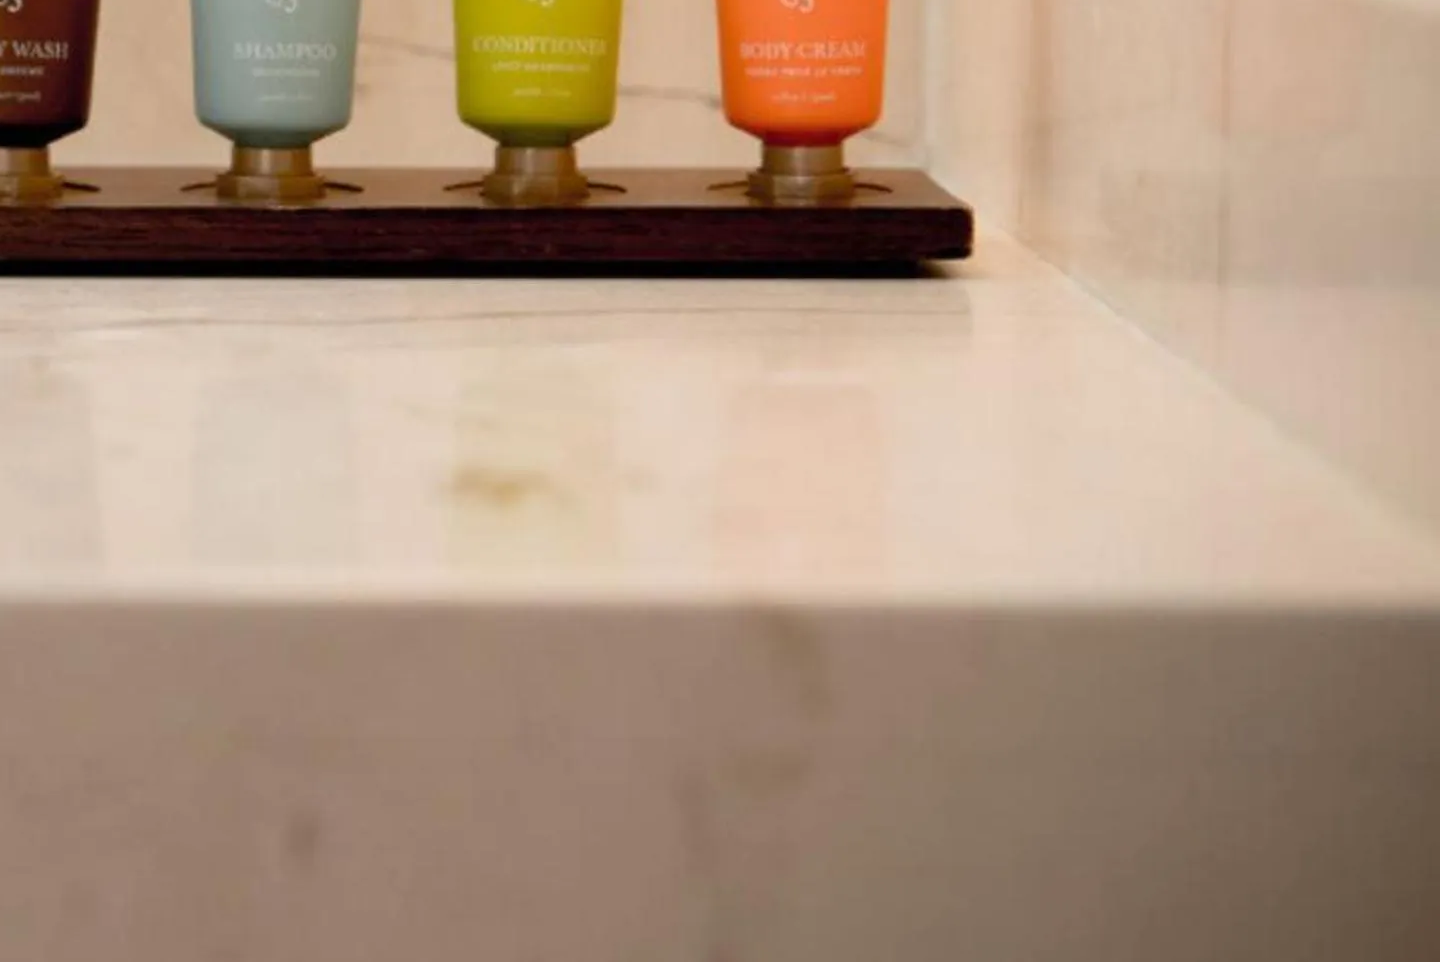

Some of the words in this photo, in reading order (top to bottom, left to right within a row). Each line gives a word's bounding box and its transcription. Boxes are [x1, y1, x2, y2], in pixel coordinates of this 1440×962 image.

[11, 39, 69, 60] WASH
[233, 41, 338, 60] SHAMPOO
[739, 41, 791, 60] BODY
[795, 39, 866, 59] CREAM
